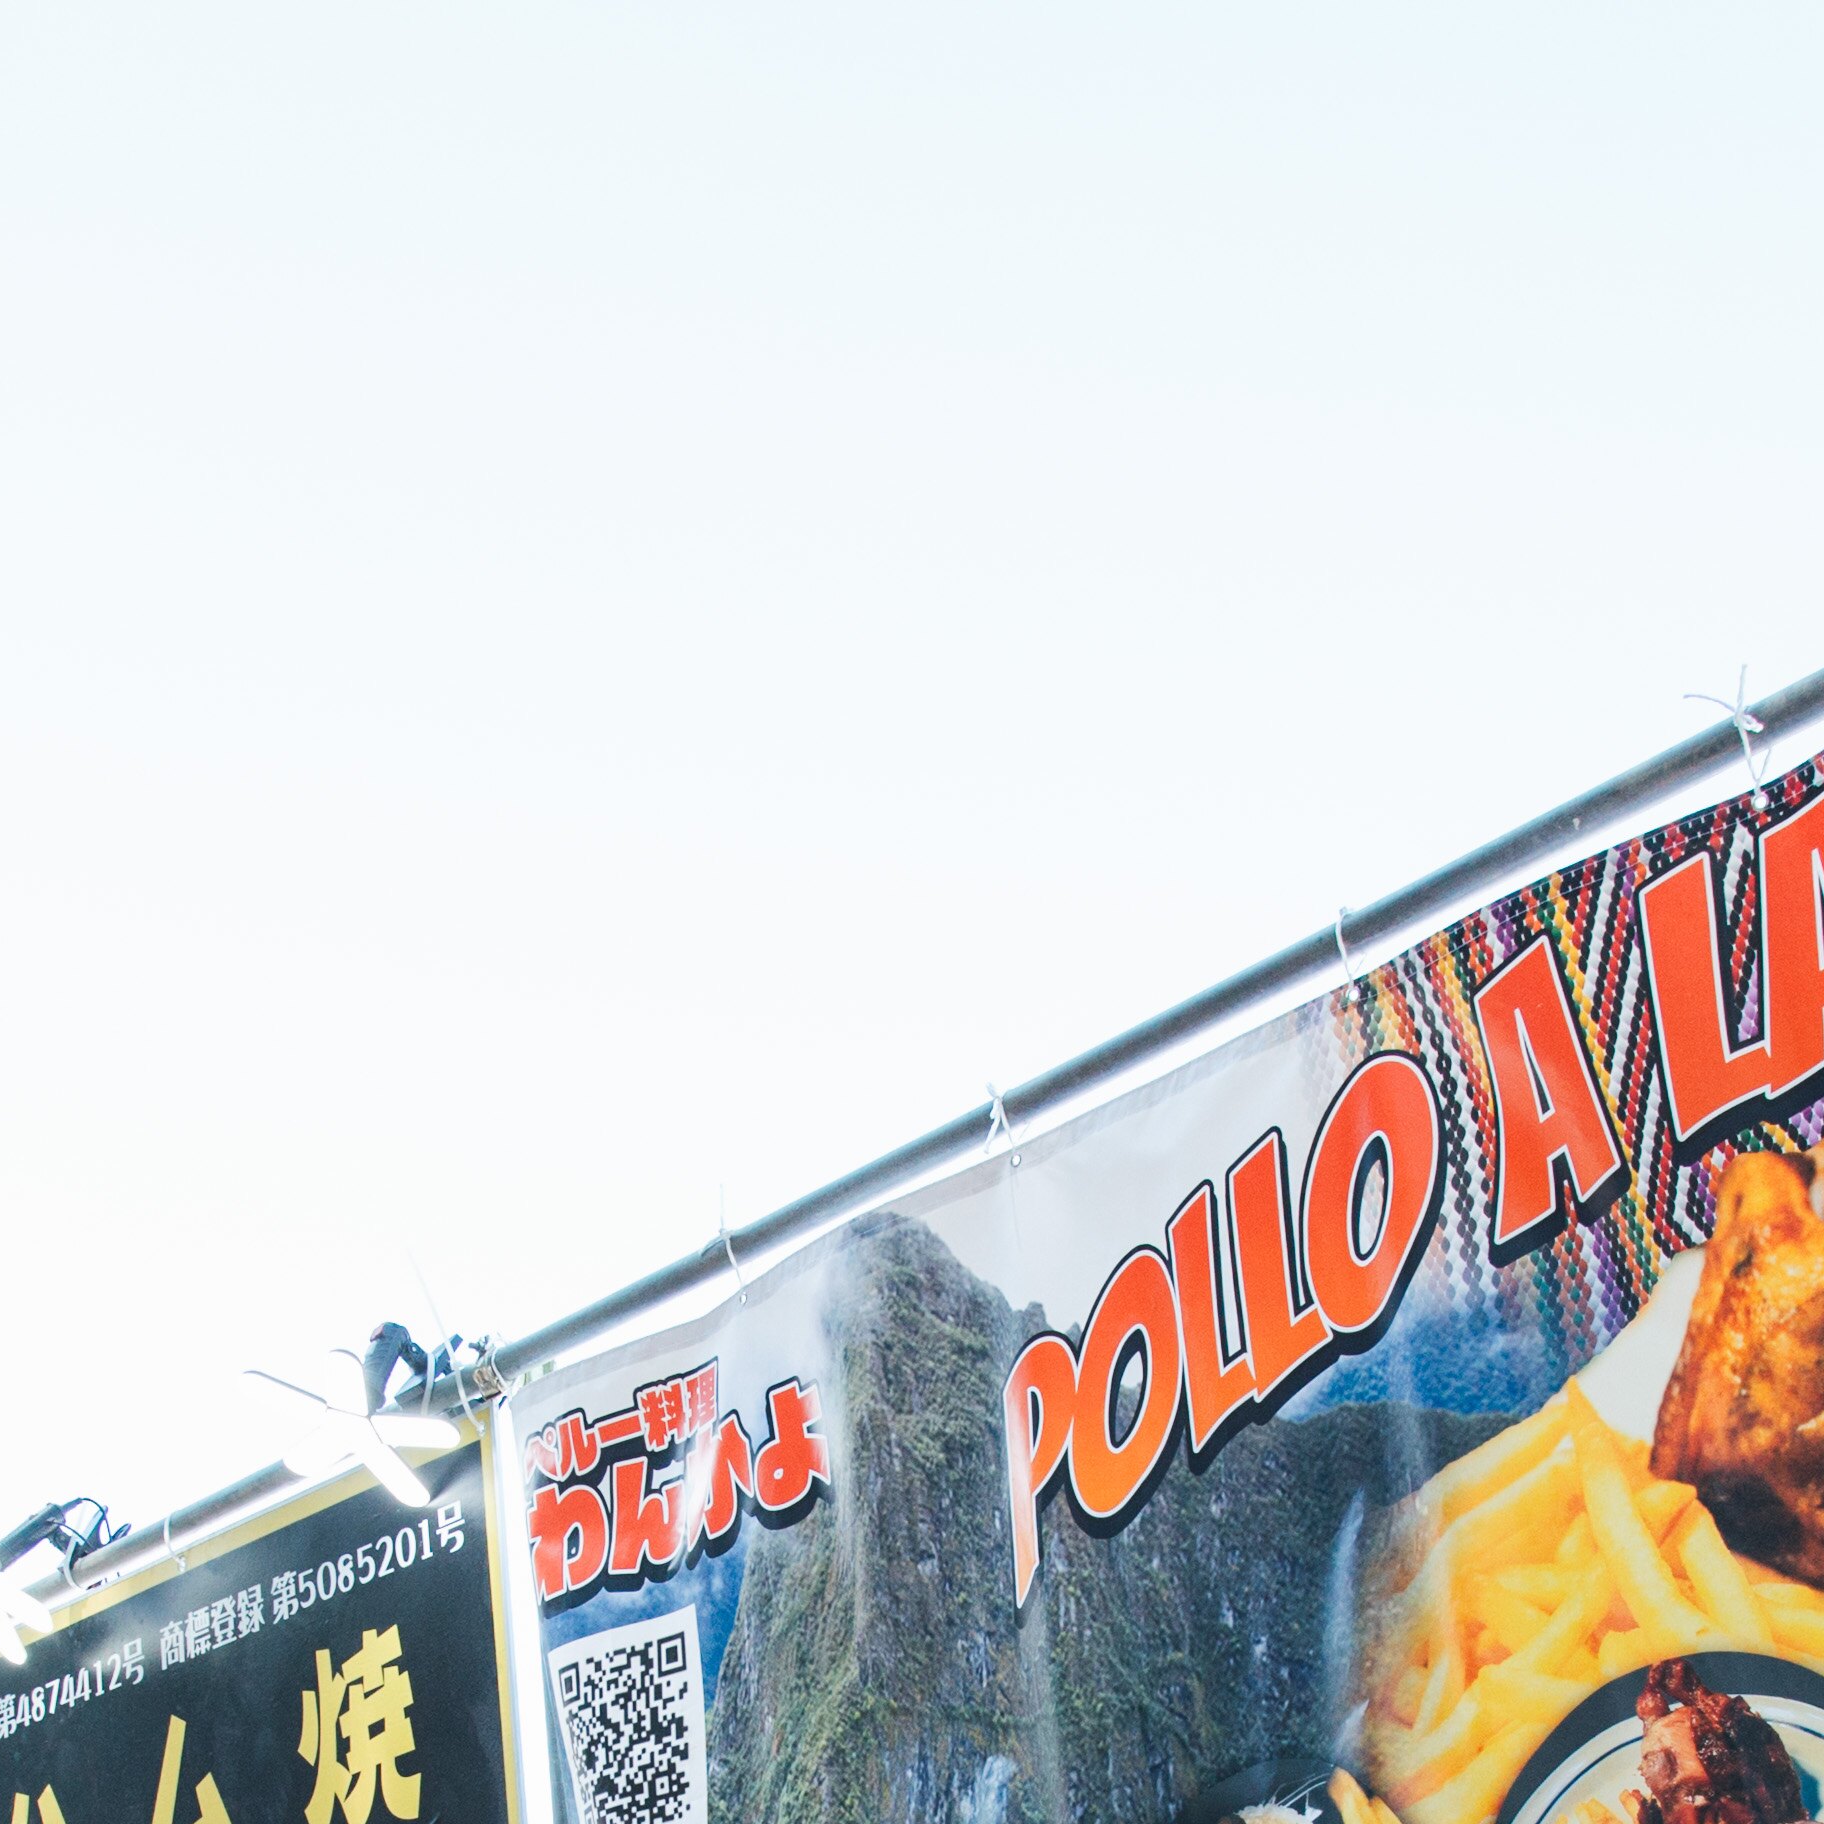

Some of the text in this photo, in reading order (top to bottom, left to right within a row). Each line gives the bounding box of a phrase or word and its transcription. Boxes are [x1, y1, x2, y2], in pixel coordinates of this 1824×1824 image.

[1003, 1053, 1440, 1610] POLLO
[1474, 940, 1624, 1246] A
[526, 1359, 718, 1482] ペルー料理
[528, 1380, 830, 1604] わんかよ
[159, 1584, 267, 1671] 商標登録
[270, 1500, 466, 1625] 第5085201号
